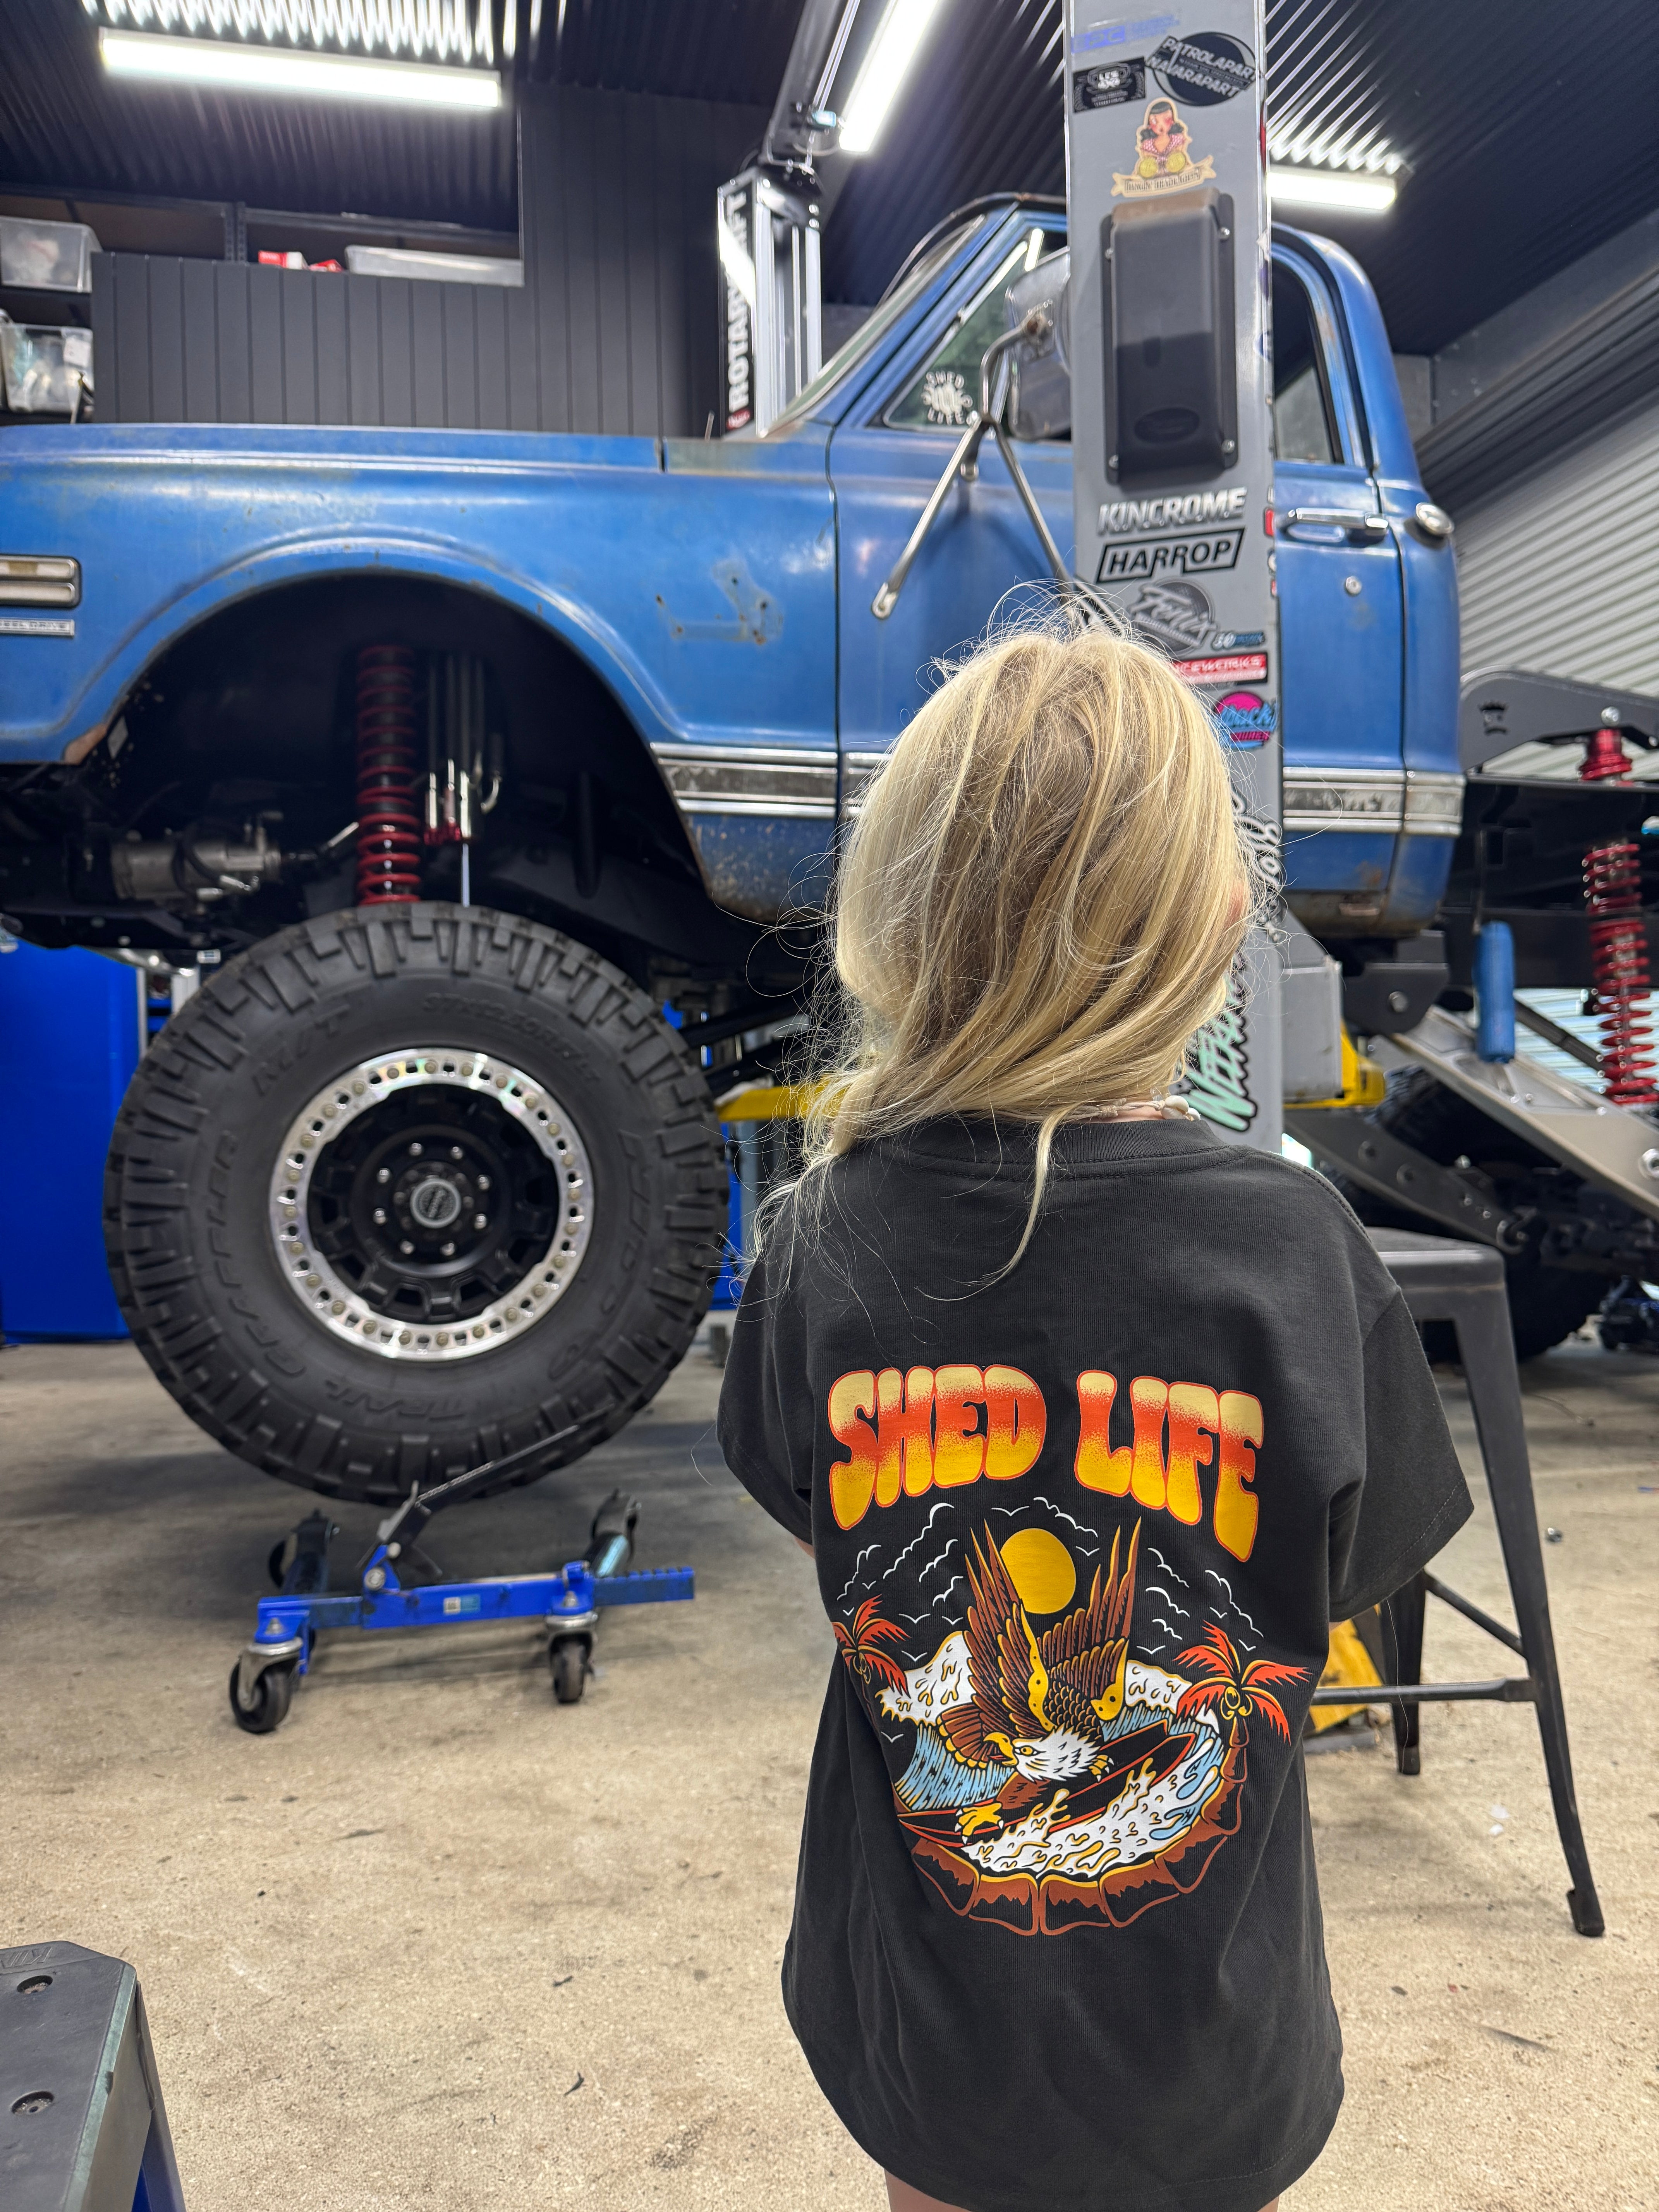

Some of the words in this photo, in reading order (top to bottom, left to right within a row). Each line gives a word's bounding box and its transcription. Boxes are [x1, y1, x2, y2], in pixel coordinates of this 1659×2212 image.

[1146, 56, 1240, 97] NAVARAPART
[1097, 487, 1247, 536] KINCROME
[1108, 539, 1231, 575] HARROP
[828, 1364, 1047, 1530] SHED
[1074, 1369, 1264, 1562] LIFE
